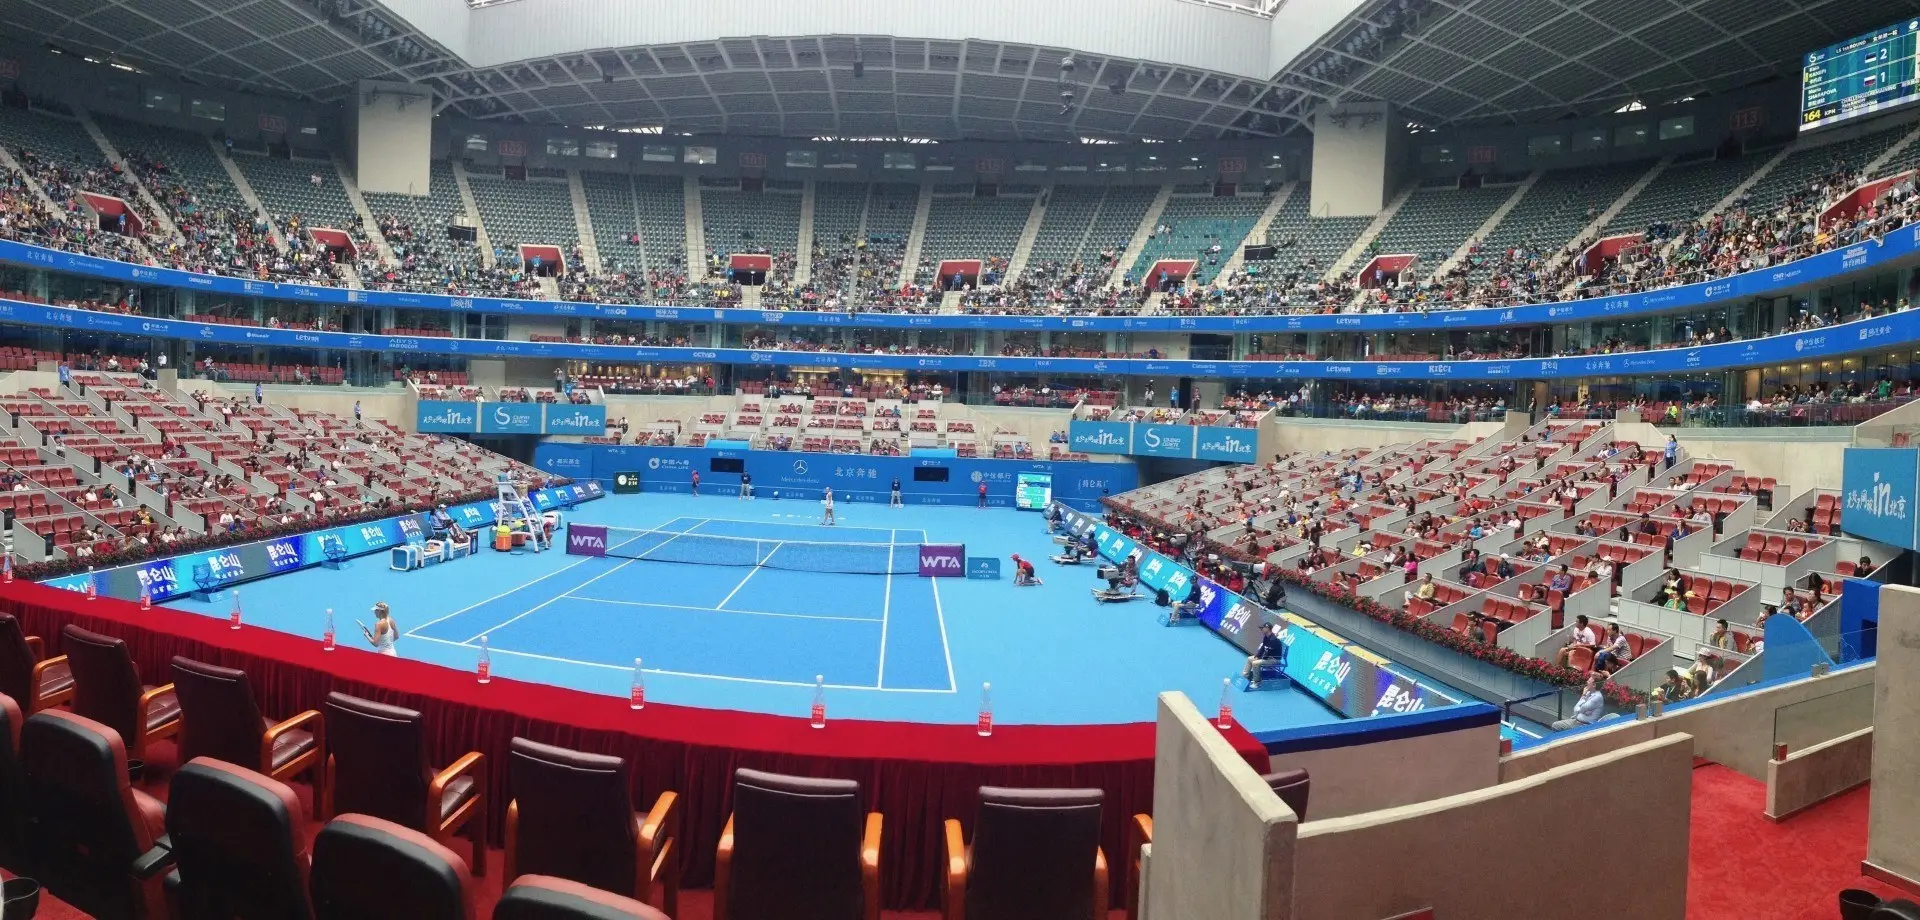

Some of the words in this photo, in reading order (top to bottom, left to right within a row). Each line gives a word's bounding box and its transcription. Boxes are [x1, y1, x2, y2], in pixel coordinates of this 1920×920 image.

[1880, 48, 1888, 60] 2
[1880, 71, 1886, 83] 1
[1803, 109, 1822, 122] 164
[1824, 108, 1836, 117] KPH
[1604, 300, 1629, 310] 北京奔驰
[1803, 336, 1826, 346] 中信银行
[978, 359, 996, 368] IBM
[1585, 360, 1611, 370] 北京奔驰
[834, 466, 877, 479] 北京奔驰
[983, 472, 1012, 480] 中信银行
[781, 475, 820, 485] Mercedes-Benz
[398, 518, 422, 533] 昆仑山
[361, 526, 386, 540] 昆仑山
[570, 534, 605, 549] WTA
[266, 542, 299, 561] 昆仑山
[207, 553, 243, 574] 昆仑山
[921, 555, 961, 568] WTA
[136, 565, 177, 586] 昆仑山
[1224, 602, 1251, 632] 昆仑山
[1313, 651, 1351, 686] 昆仑山
[1378, 684, 1425, 713] 昆仑山
